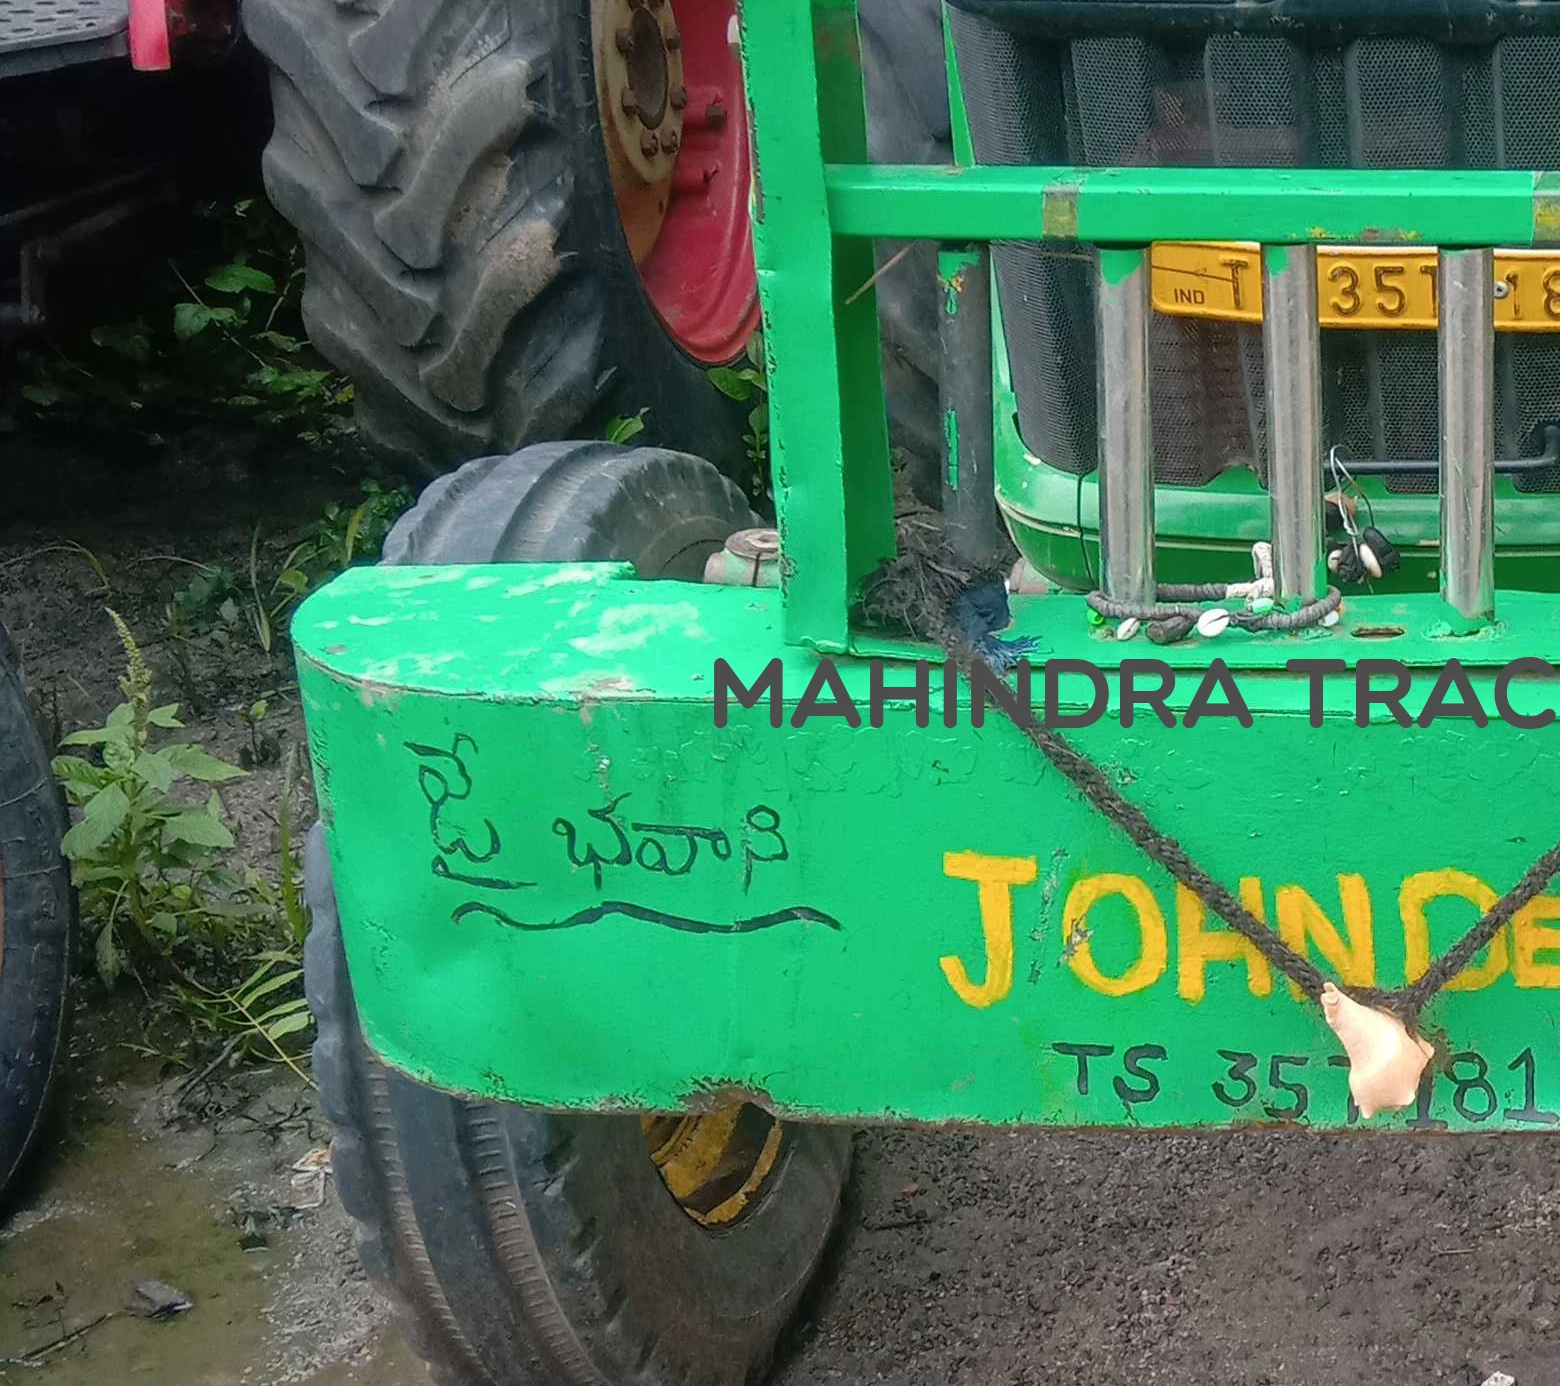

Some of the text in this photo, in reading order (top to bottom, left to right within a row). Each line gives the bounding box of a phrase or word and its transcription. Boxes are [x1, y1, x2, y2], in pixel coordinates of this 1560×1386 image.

[1173, 287, 1206, 305] IND
[939, 851, 1377, 1009] JOHN
[1051, 1041, 1169, 1104] TS
